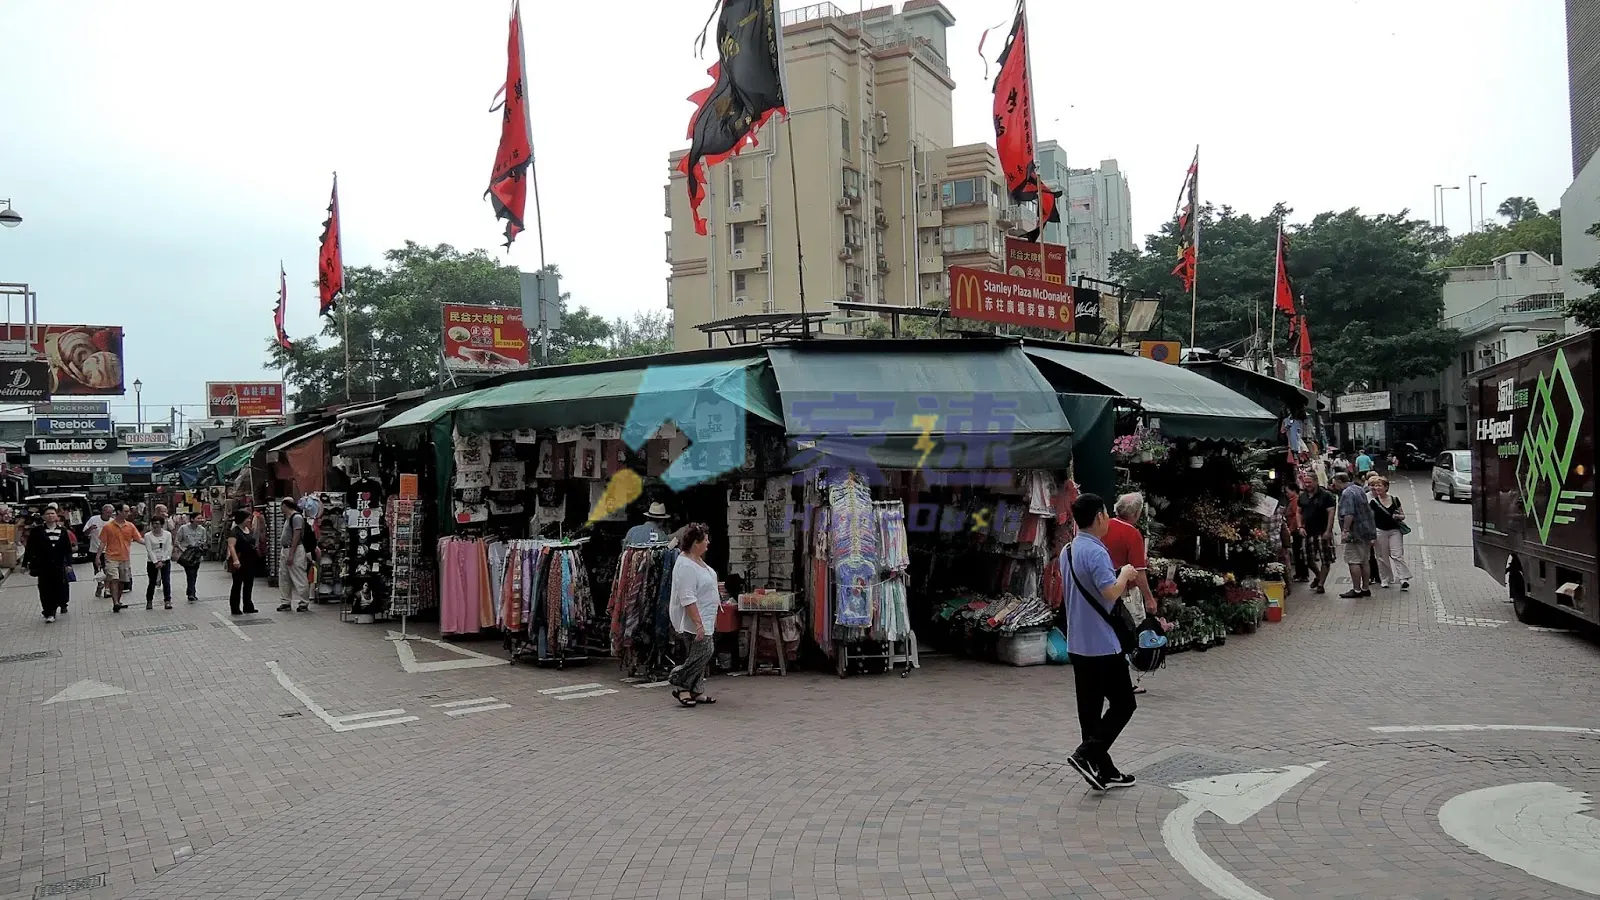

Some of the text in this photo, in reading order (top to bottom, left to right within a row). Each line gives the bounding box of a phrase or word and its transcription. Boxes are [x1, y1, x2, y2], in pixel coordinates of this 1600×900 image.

[983, 279, 1071, 304] Stanley Plaza McDonald's
[449, 311, 504, 324] 民益大牌檔
[0, 388, 43, 396] élifrance
[50, 420, 95, 429] Reebok
[1476, 414, 1514, 444] Hi-Speed
[36, 439, 93, 451] Timberland
[357, 500, 371, 509] HK
[357, 519, 371, 527] HK
